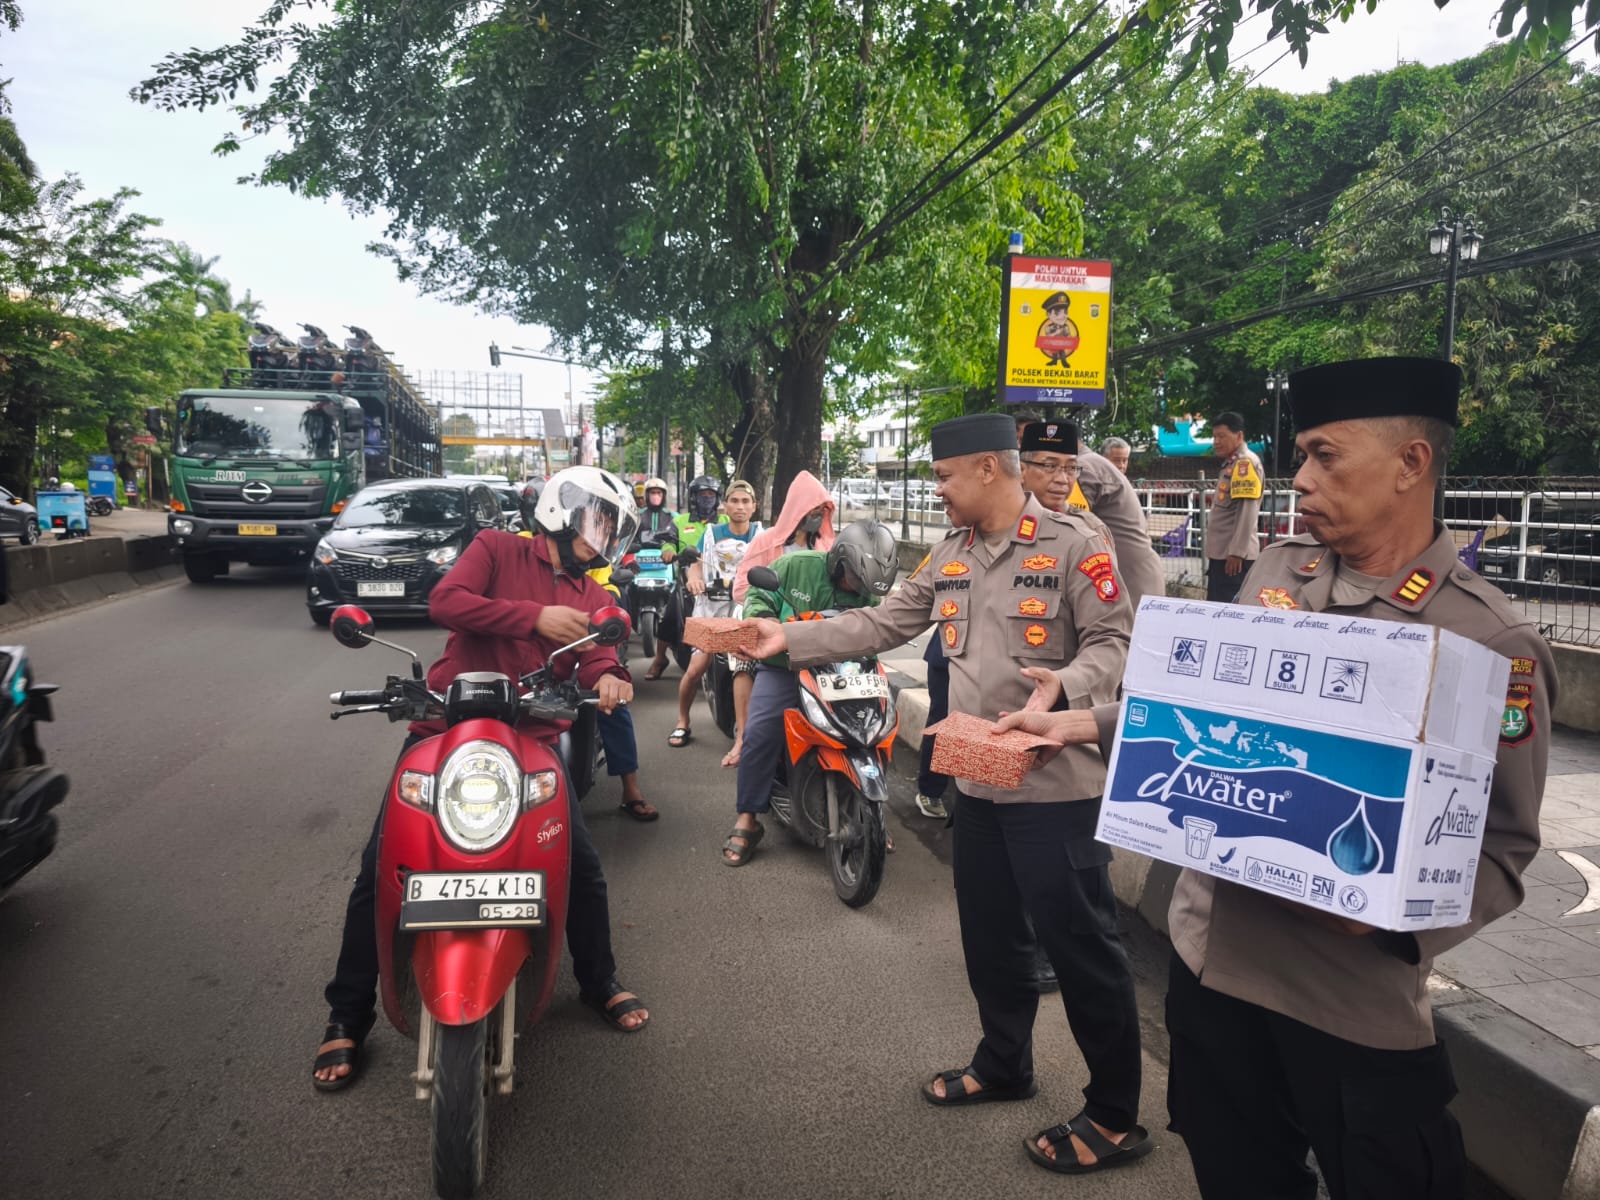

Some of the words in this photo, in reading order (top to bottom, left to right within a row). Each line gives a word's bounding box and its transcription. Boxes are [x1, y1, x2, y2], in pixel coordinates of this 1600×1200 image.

[1060, 266, 1087, 275] UNTUK
[1034, 274, 1087, 285] MASYARAKAT
[1012, 368, 1041, 376] POLSEK
[1044, 370, 1072, 378] BEKASI
[1046, 388, 1072, 397] YSP
[1013, 575, 1059, 588] POLRI
[790, 588, 811, 602] Grab
[1282, 652, 1298, 660] MAX
[1278, 661, 1296, 682] 8
[820, 677, 827, 687] B
[1273, 681, 1297, 690] SUSUN
[1210, 771, 1236, 783] DALWA
[537, 822, 563, 843] Stylish
[1210, 862, 1227, 871] BADAN
[1266, 865, 1303, 883] HALAL
[1418, 868, 1428, 882] ISI
[1445, 869, 1456, 883] 240
[411, 880, 422, 899] B
[439, 878, 488, 898] 4754
[1312, 878, 1335, 896] SNI
